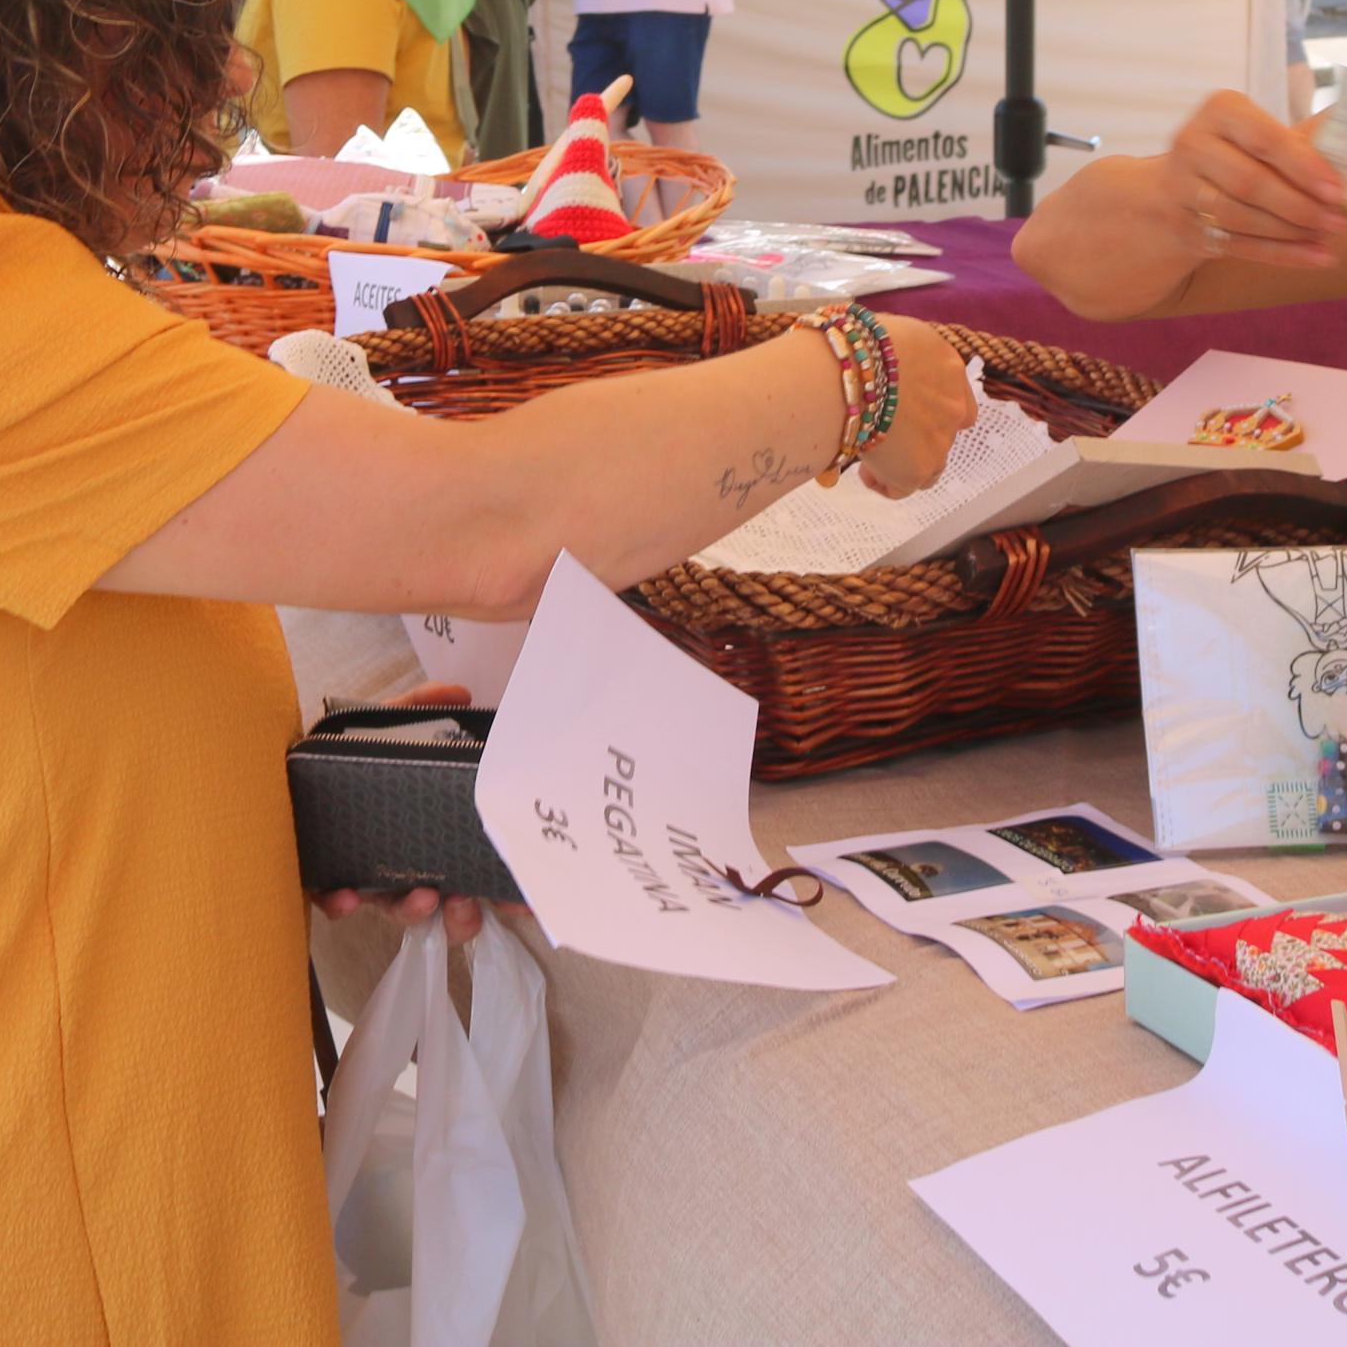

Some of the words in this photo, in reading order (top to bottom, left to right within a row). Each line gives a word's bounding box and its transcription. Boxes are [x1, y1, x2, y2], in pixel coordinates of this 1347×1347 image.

[852, 130, 968, 171] Alimentos
[865, 180, 886, 205] de
[534, 798, 578, 852] 3€
[603, 745, 690, 913] PEGATINA
[1132, 1248, 1211, 1299] 5€
